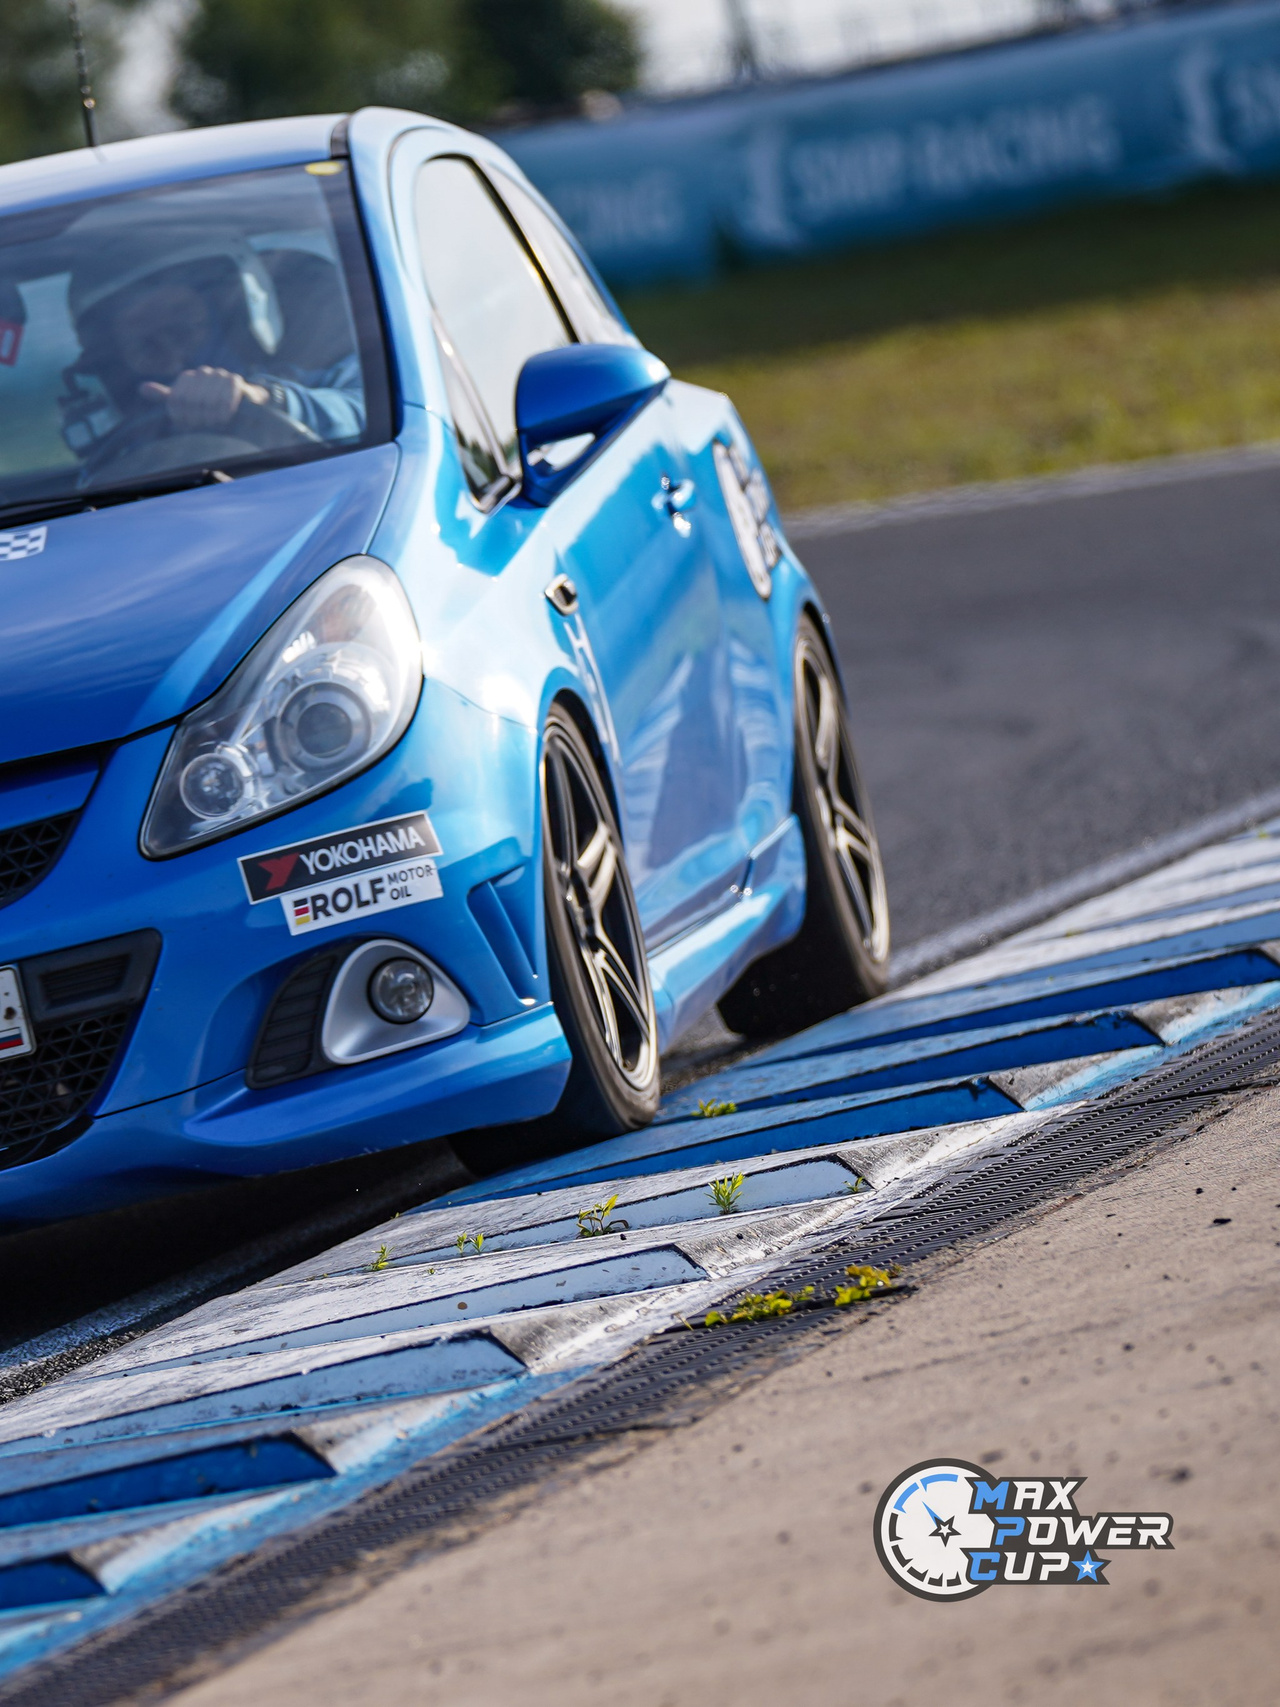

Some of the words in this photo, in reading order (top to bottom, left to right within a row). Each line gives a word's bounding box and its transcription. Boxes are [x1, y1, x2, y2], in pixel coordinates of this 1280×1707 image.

[299, 826, 426, 876] YOKOHAMA
[310, 877, 386, 921] ROLF
[387, 864, 435, 886] MOTOR
[389, 884, 412, 901] OIL
